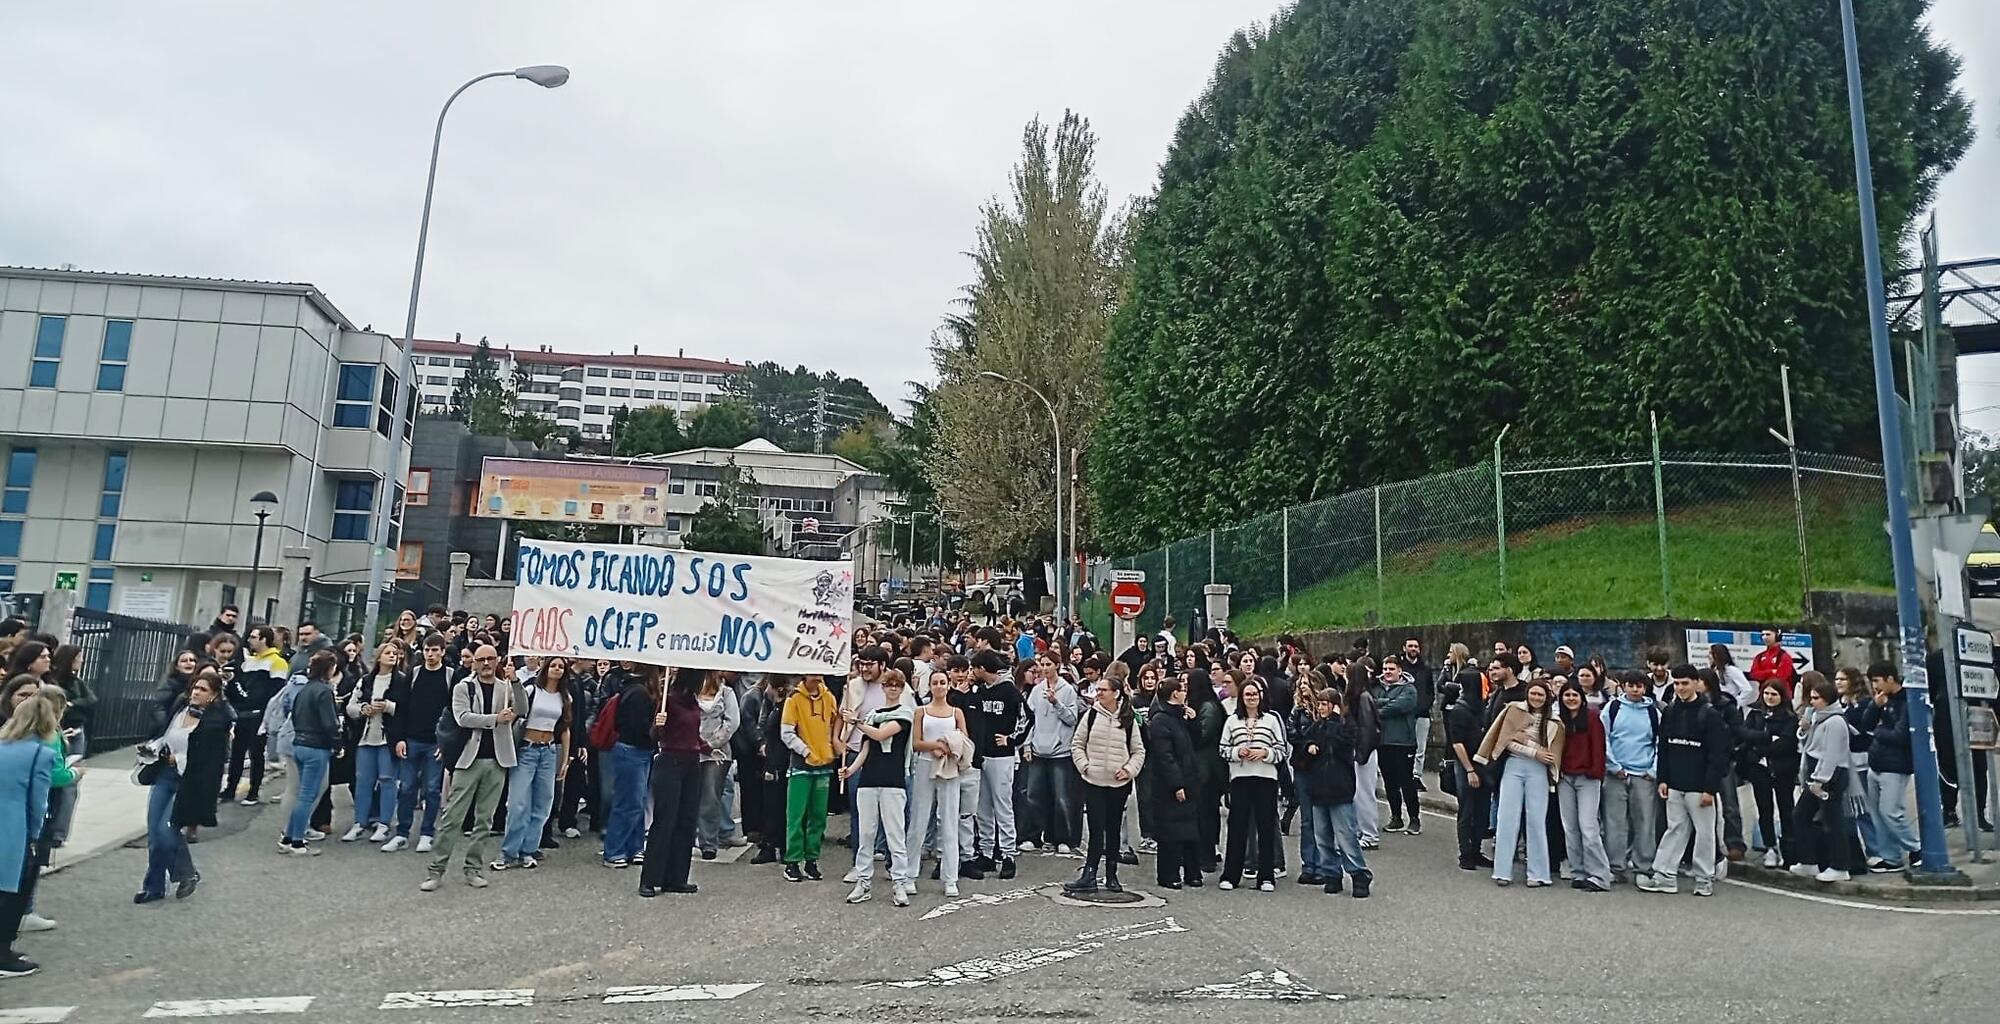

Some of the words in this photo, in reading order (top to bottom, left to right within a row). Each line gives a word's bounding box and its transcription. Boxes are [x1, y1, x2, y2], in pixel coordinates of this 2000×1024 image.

[516, 546, 585, 589] FOMOS
[588, 551, 675, 598] FICANDO
[656, 632, 666, 649] e
[670, 632, 717, 651] mais
[717, 612, 775, 661] NÓS
[797, 622, 816, 635] en
[787, 636, 846, 668] loita!
